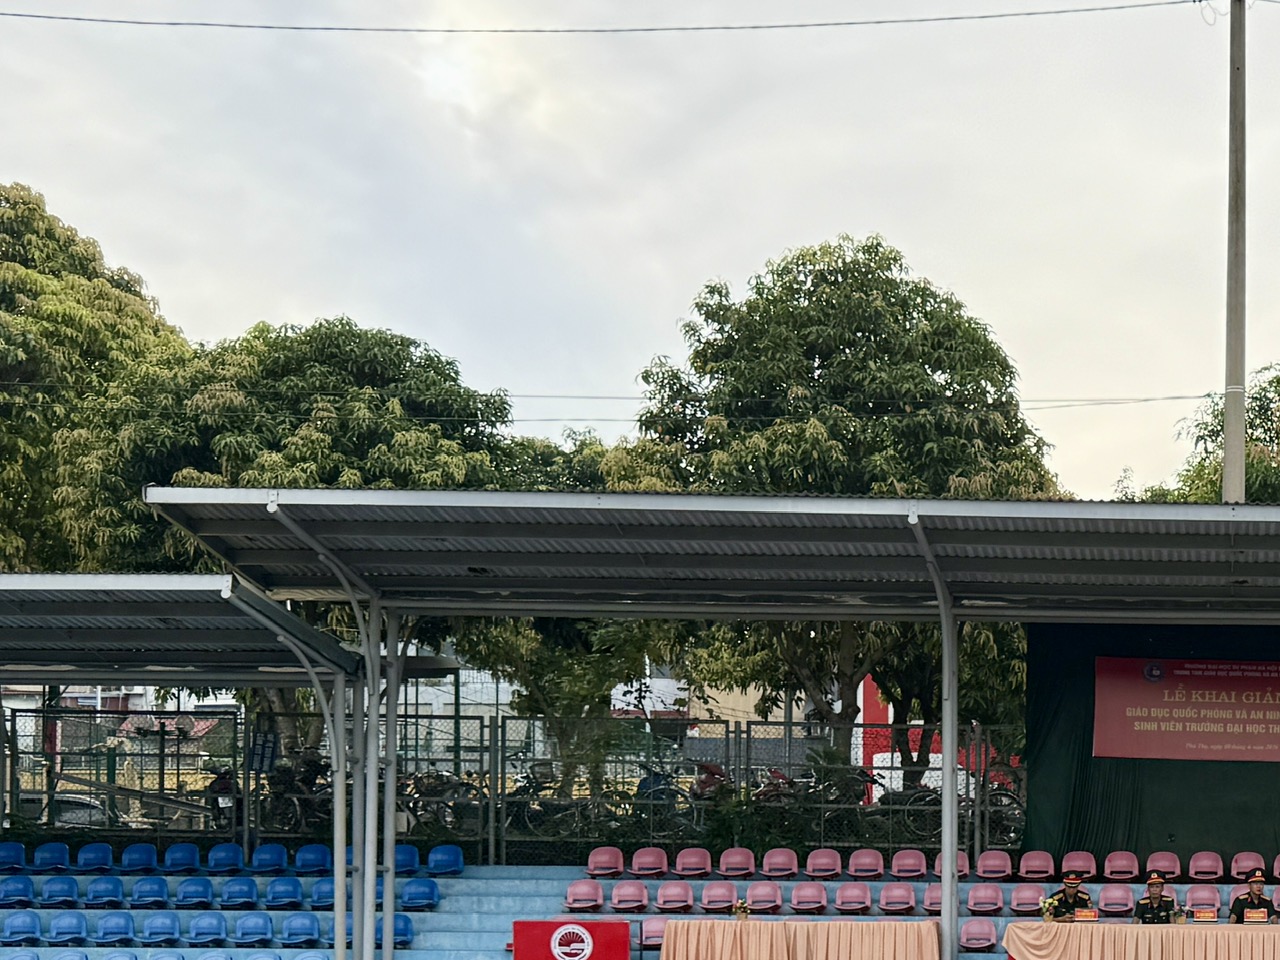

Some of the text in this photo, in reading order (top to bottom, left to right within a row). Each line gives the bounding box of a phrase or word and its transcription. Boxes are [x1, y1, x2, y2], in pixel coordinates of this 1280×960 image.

[1190, 690, 1237, 702] KHAI
[1126, 705, 1148, 717] GIÁO
[1151, 708, 1170, 720] DỤC
[1172, 706, 1198, 718] QUỐC
[1250, 710, 1264, 719] AN
[1134, 721, 1158, 731] SINH
[1160, 720, 1183, 731] VIÊN
[1245, 724, 1266, 735] HỌC
